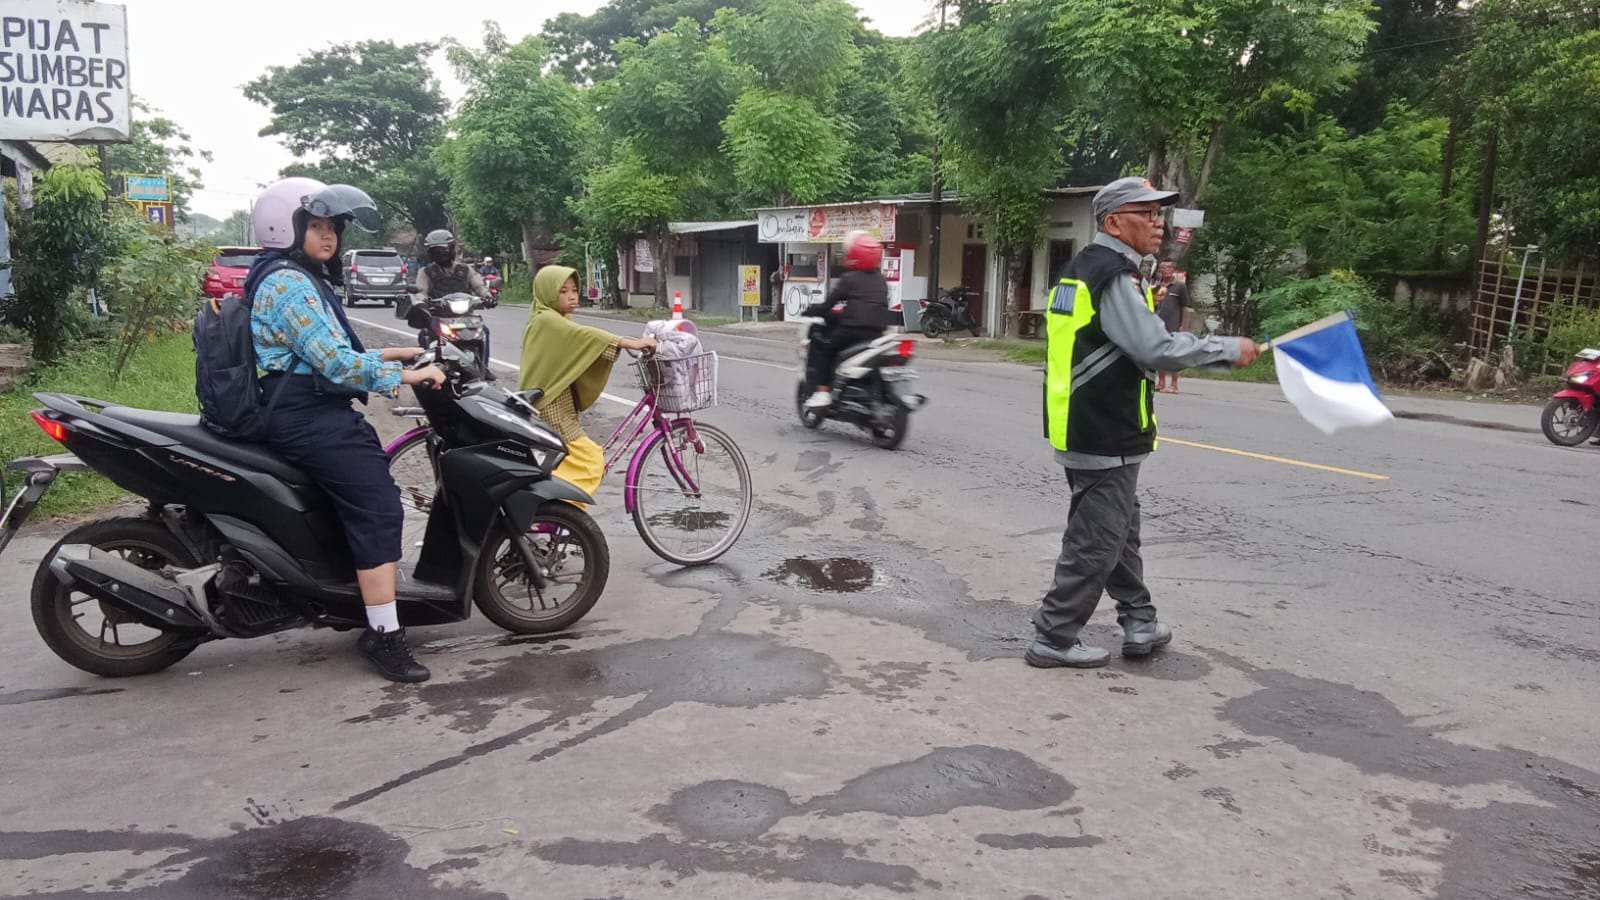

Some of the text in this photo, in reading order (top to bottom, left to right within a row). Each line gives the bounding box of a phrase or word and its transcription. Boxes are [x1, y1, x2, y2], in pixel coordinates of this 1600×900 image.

[3, 17, 110, 53] PIJAT
[0, 52, 125, 89] SUMBER
[2, 86, 114, 123] WARAS
[497, 445, 527, 458] HONDA
